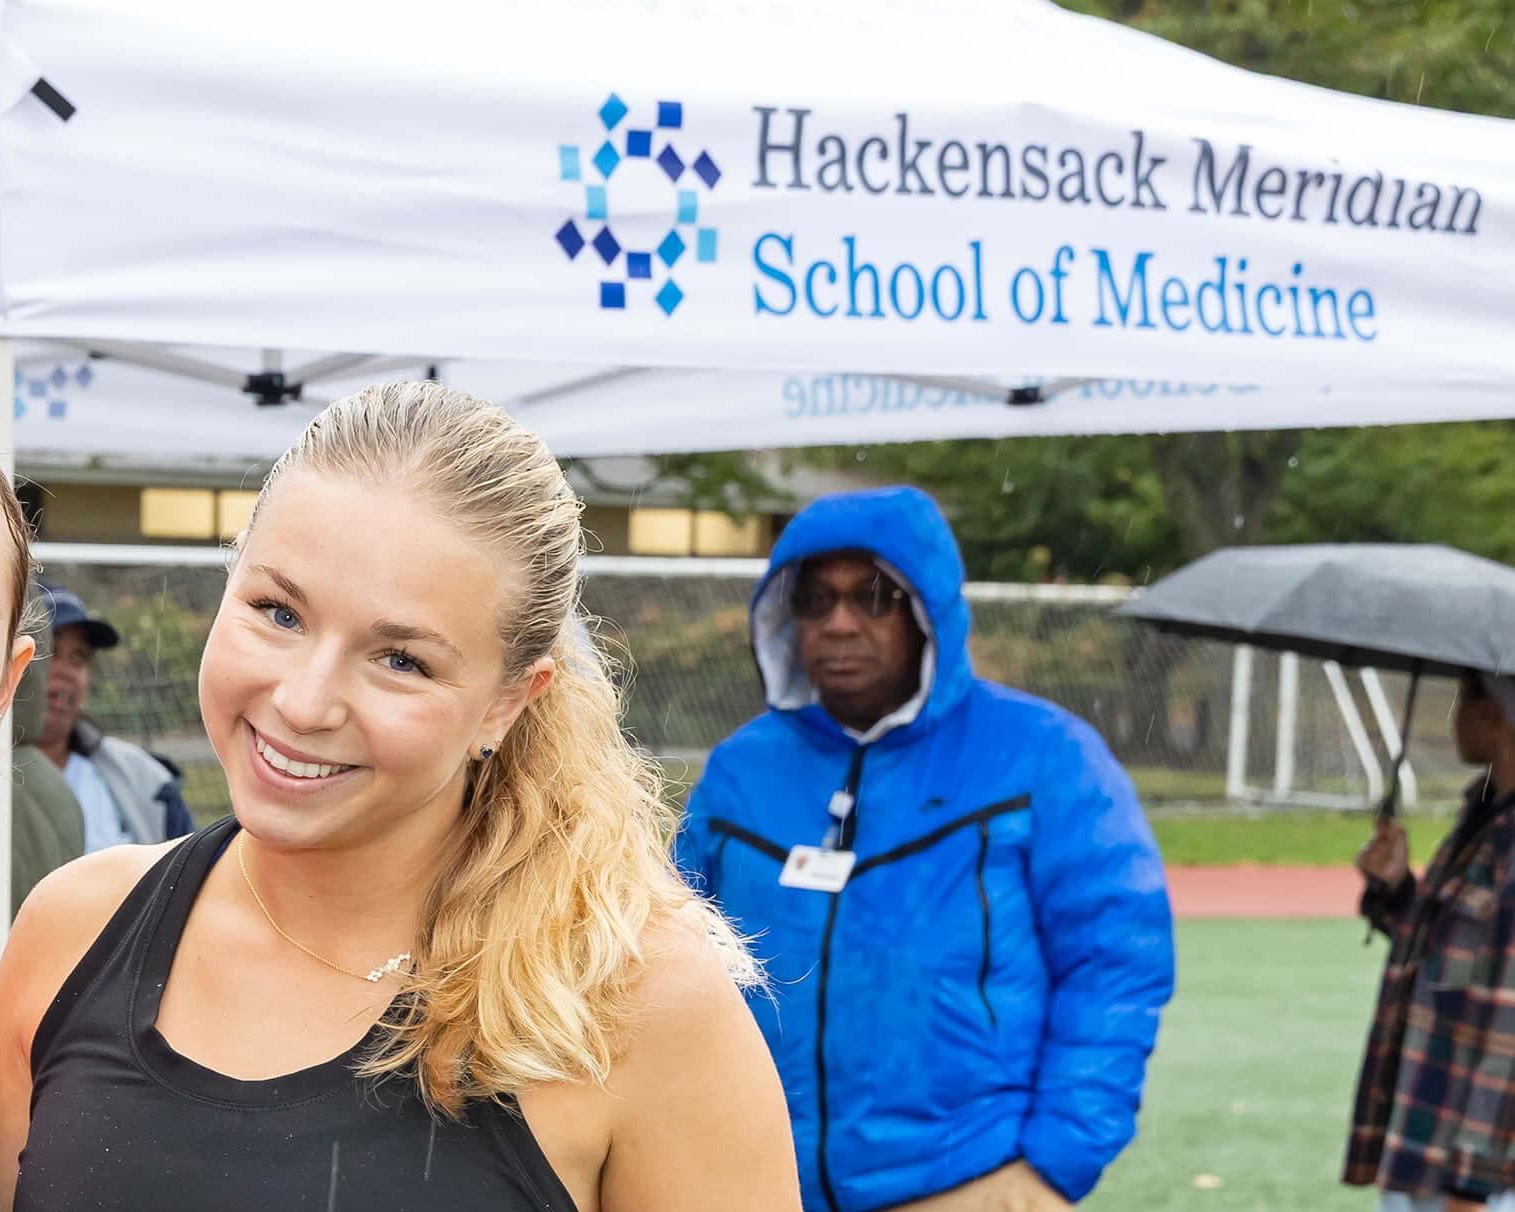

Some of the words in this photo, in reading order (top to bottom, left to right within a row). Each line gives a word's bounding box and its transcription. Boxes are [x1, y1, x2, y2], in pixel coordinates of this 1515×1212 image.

[752, 106, 1167, 211] Hackensack
[1189, 138, 1482, 234] Meridian
[752, 231, 989, 321] School
[1011, 244, 1076, 326] of
[1091, 249, 1378, 342] Medicine
